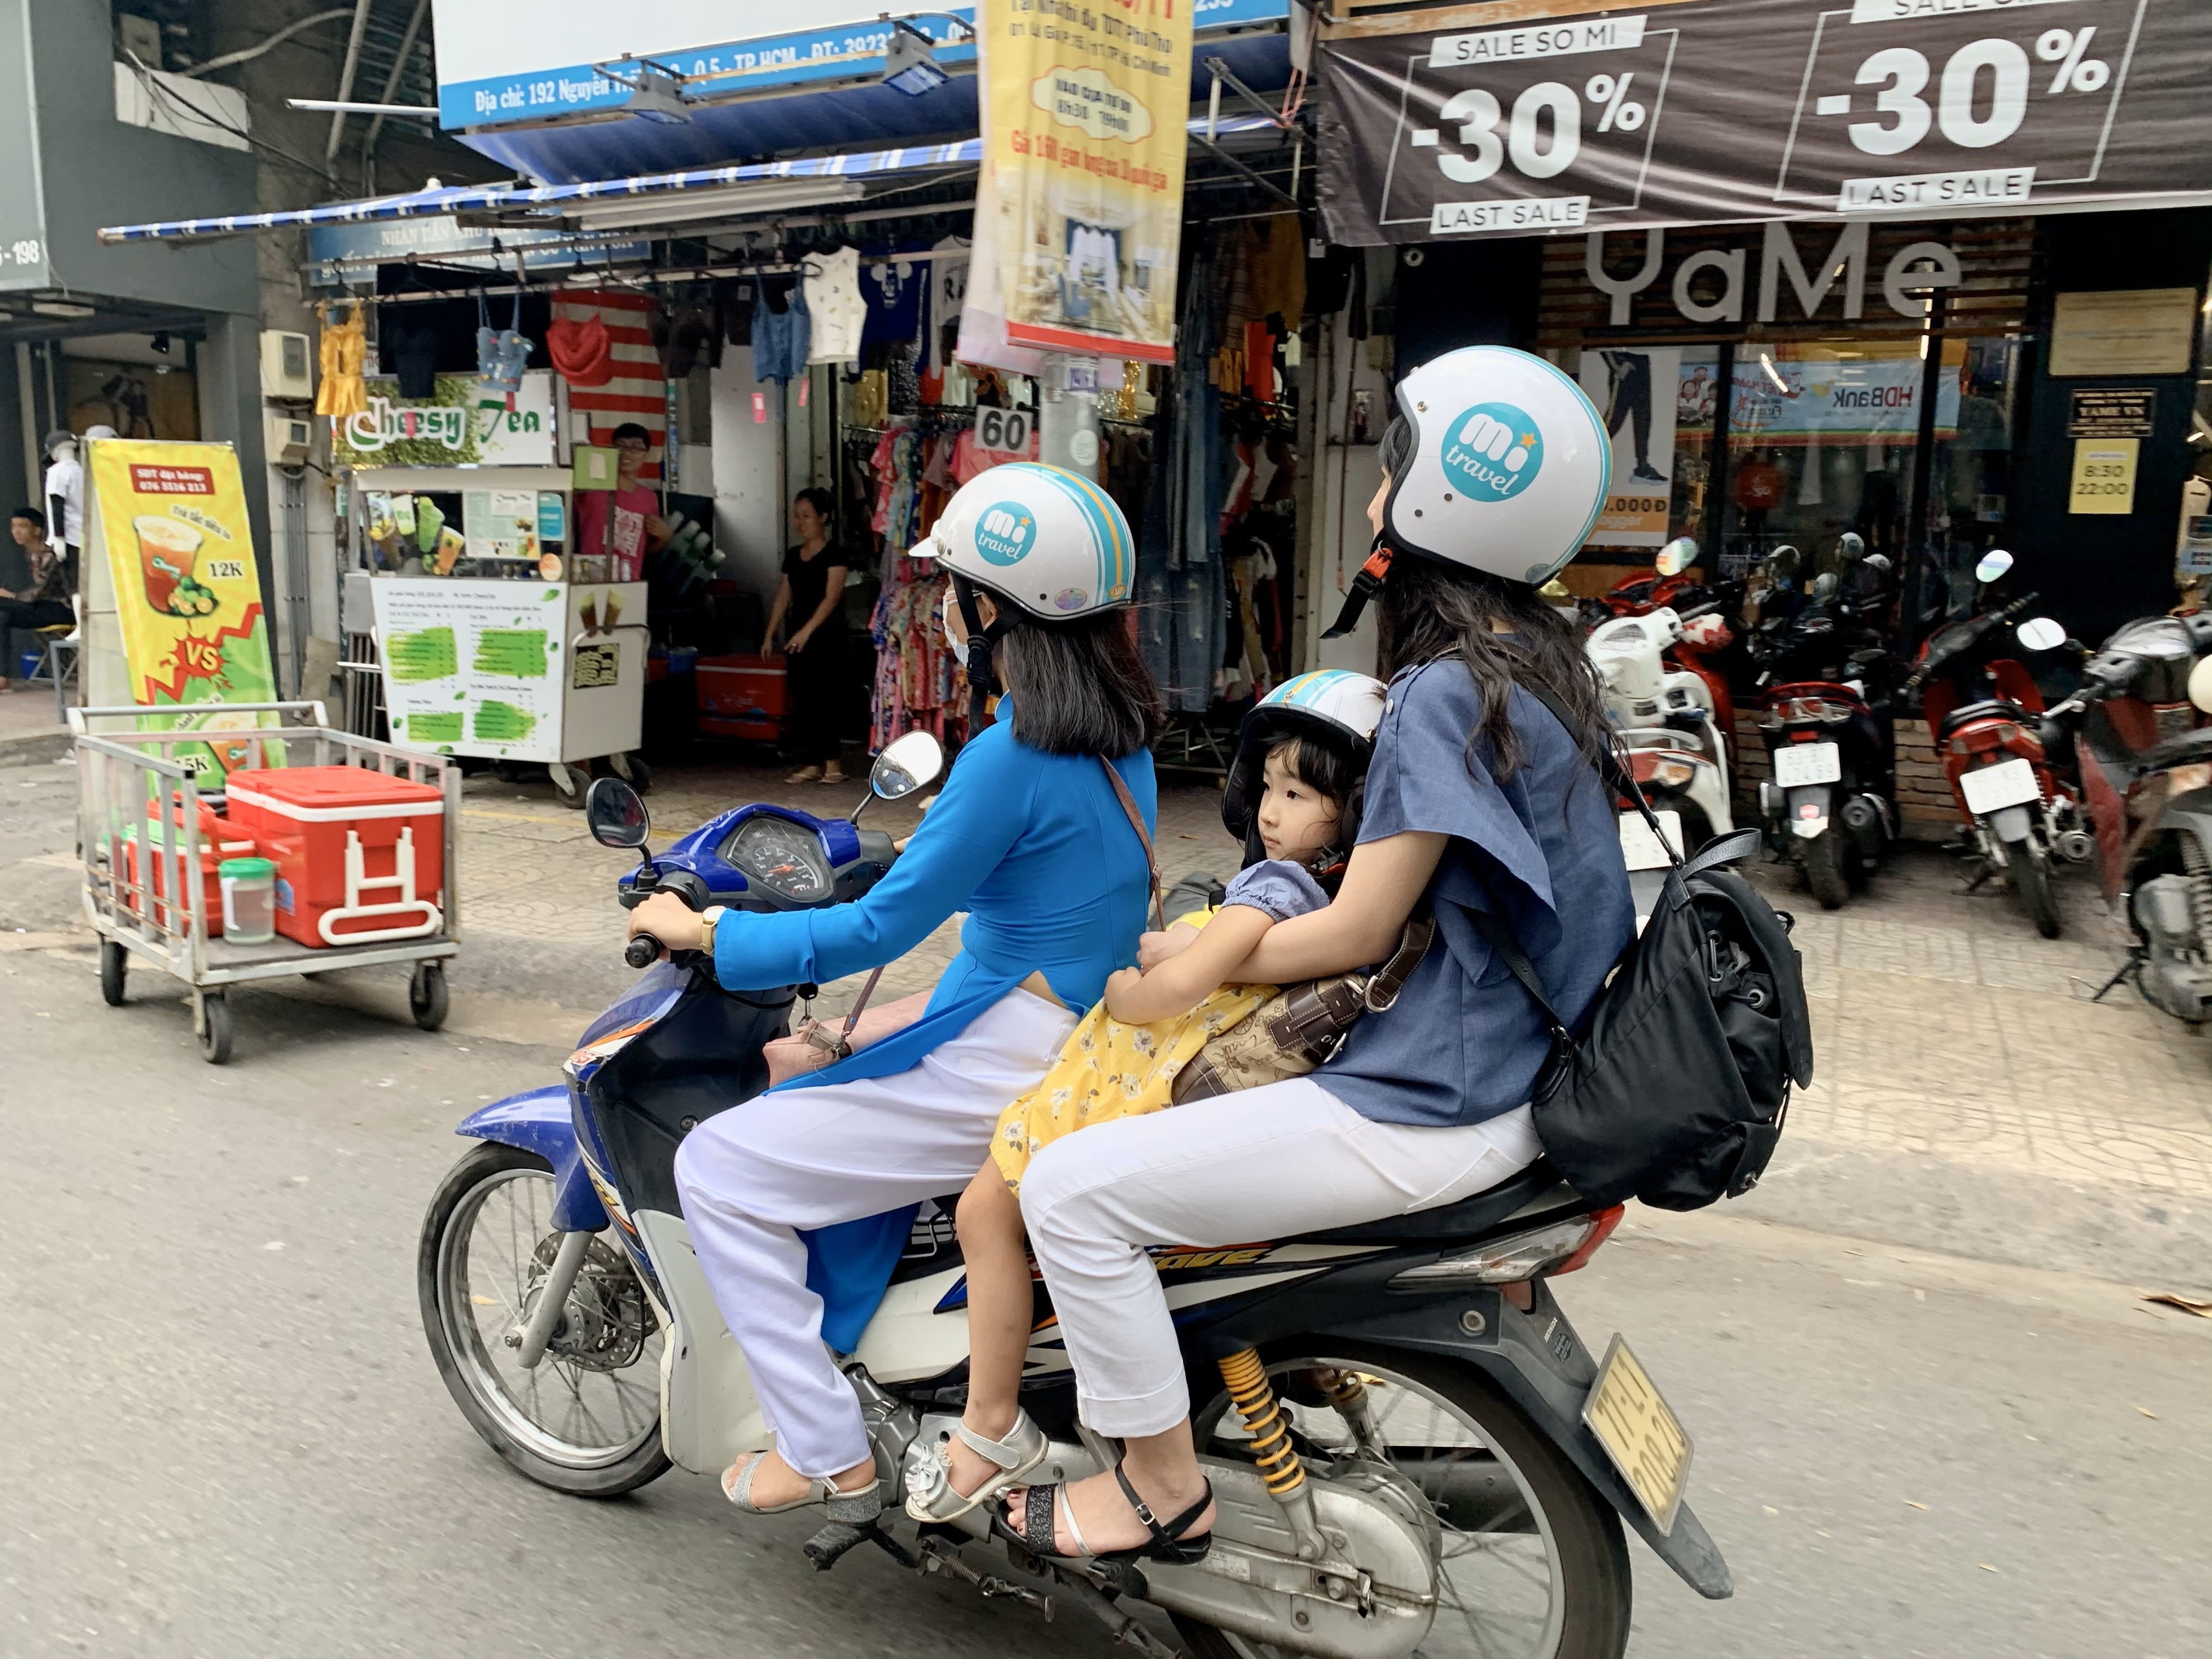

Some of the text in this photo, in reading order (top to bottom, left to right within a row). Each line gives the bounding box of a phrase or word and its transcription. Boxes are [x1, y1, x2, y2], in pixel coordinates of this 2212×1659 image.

[1455, 34, 1525, 60] SALE
[1585, 24, 1616, 47] MI
[529, 80, 556, 105] 192
[1816, 26, 2111, 155] -30%
[1411, 71, 1645, 183] -30%
[1848, 174, 2023, 206] LAST SALE
[1438, 202, 1581, 229] LAST SALE
[0, 240, 40, 267] -198
[1585, 221, 1962, 326] YaMe
[478, 399, 540, 443] Tea
[981, 410, 1025, 451] 60
[1446, 445, 1519, 495] travel
[2084, 465, 2126, 477] 8:30
[2076, 483, 2130, 495] 22:00
[978, 532, 1023, 560] travel
[210, 562, 243, 577] 12K
[185, 640, 218, 672] VS
[1152, 1248, 1273, 1271] ave
[1544, 1317, 1558, 1343] HONDA
